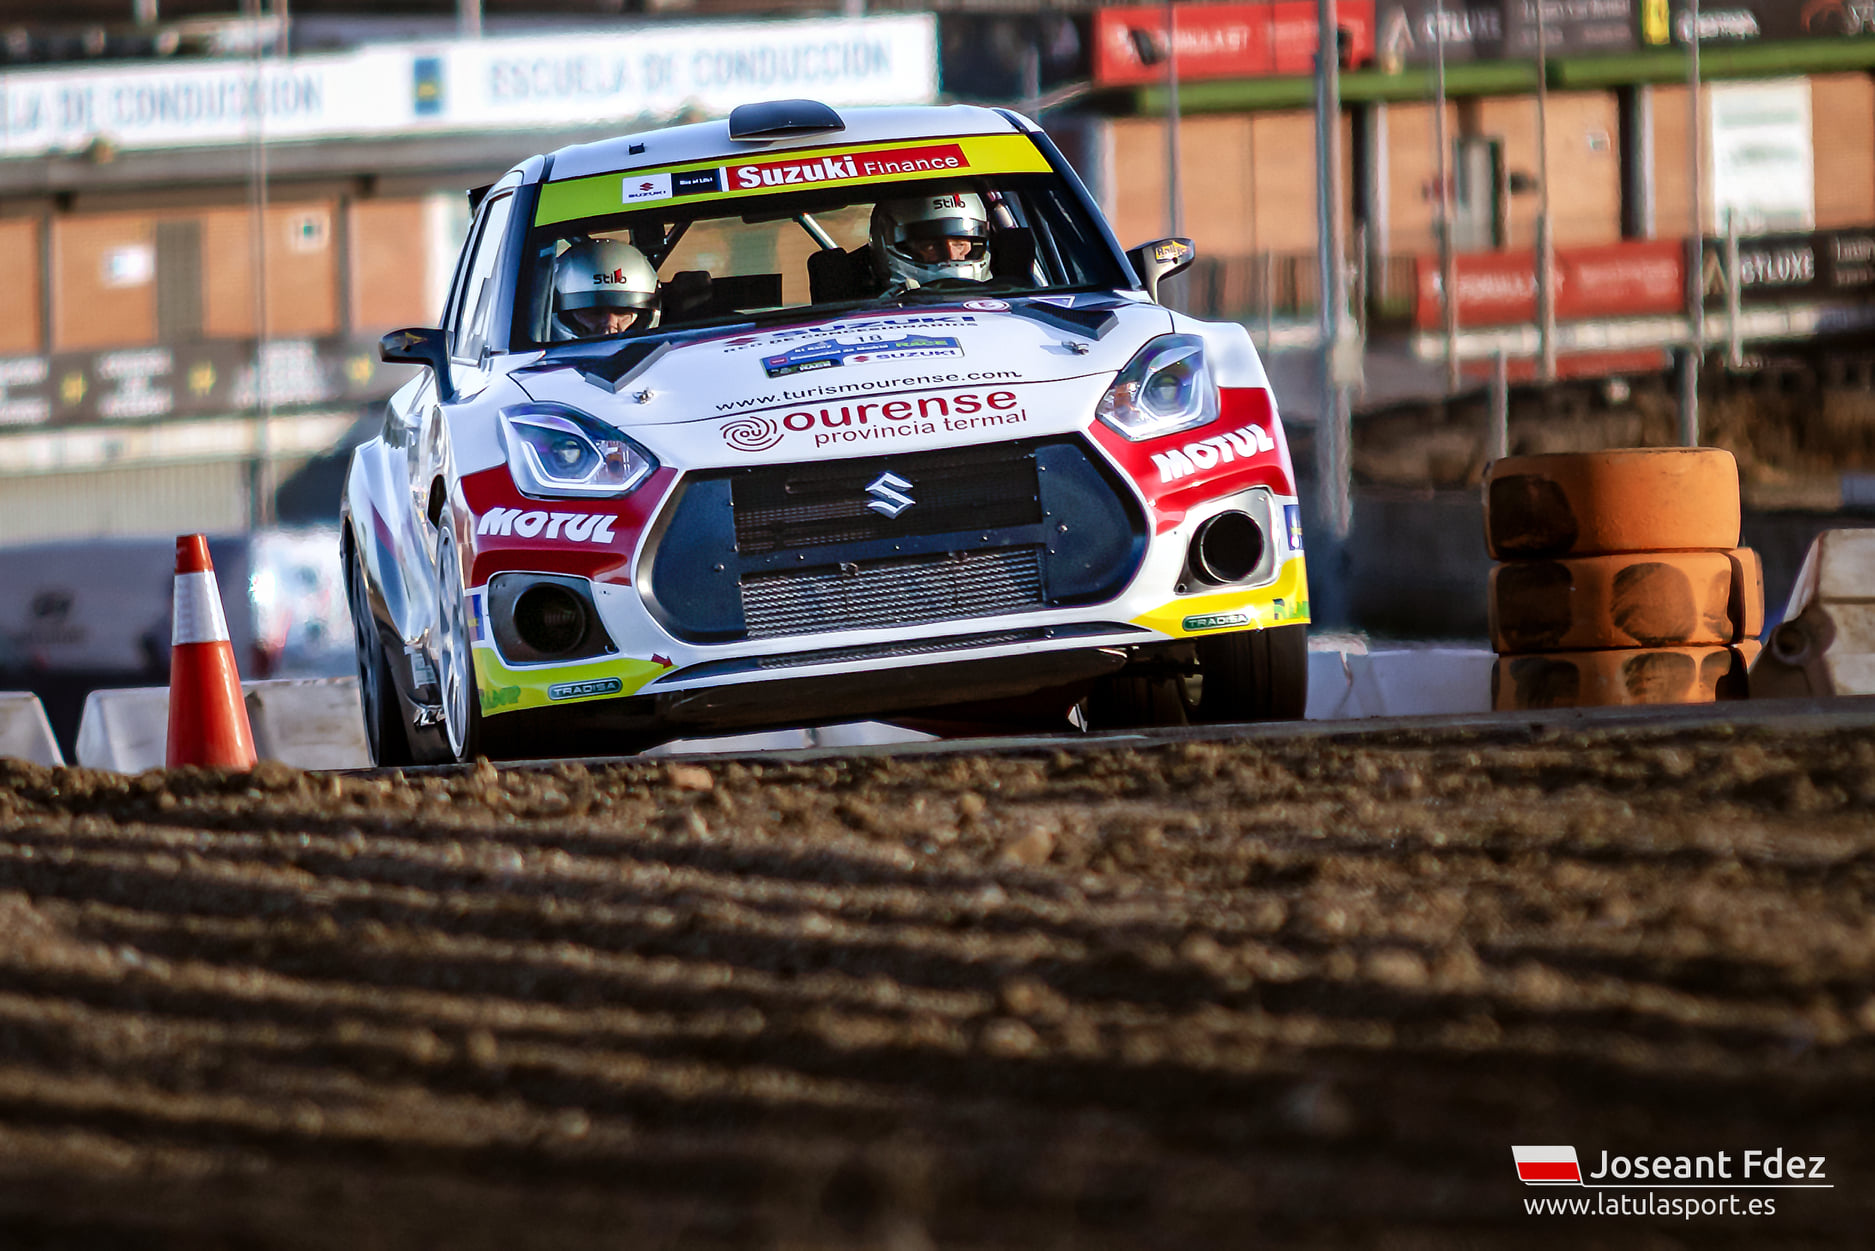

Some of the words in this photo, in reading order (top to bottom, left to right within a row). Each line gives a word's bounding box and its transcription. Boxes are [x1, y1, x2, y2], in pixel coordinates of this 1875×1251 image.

[737, 155, 859, 189] Suzuki
[865, 154, 959, 176] Finance
[628, 190, 667, 198] SUZUKI
[933, 193, 966, 210] Stilo
[593, 267, 627, 285] Stilo
[772, 315, 976, 337] SUZUKI
[876, 349, 956, 360] SUZUKI
[715, 370, 1023, 411] www.turismourense.com
[783, 391, 1018, 432] ourense
[815, 420, 936, 449] provincia
[943, 409, 1027, 432] termal
[1150, 424, 1275, 484] MOTUL
[477, 507, 618, 544] MOTUL
[1188, 614, 1249, 627] TRADISA
[553, 682, 617, 697] TRADISA
